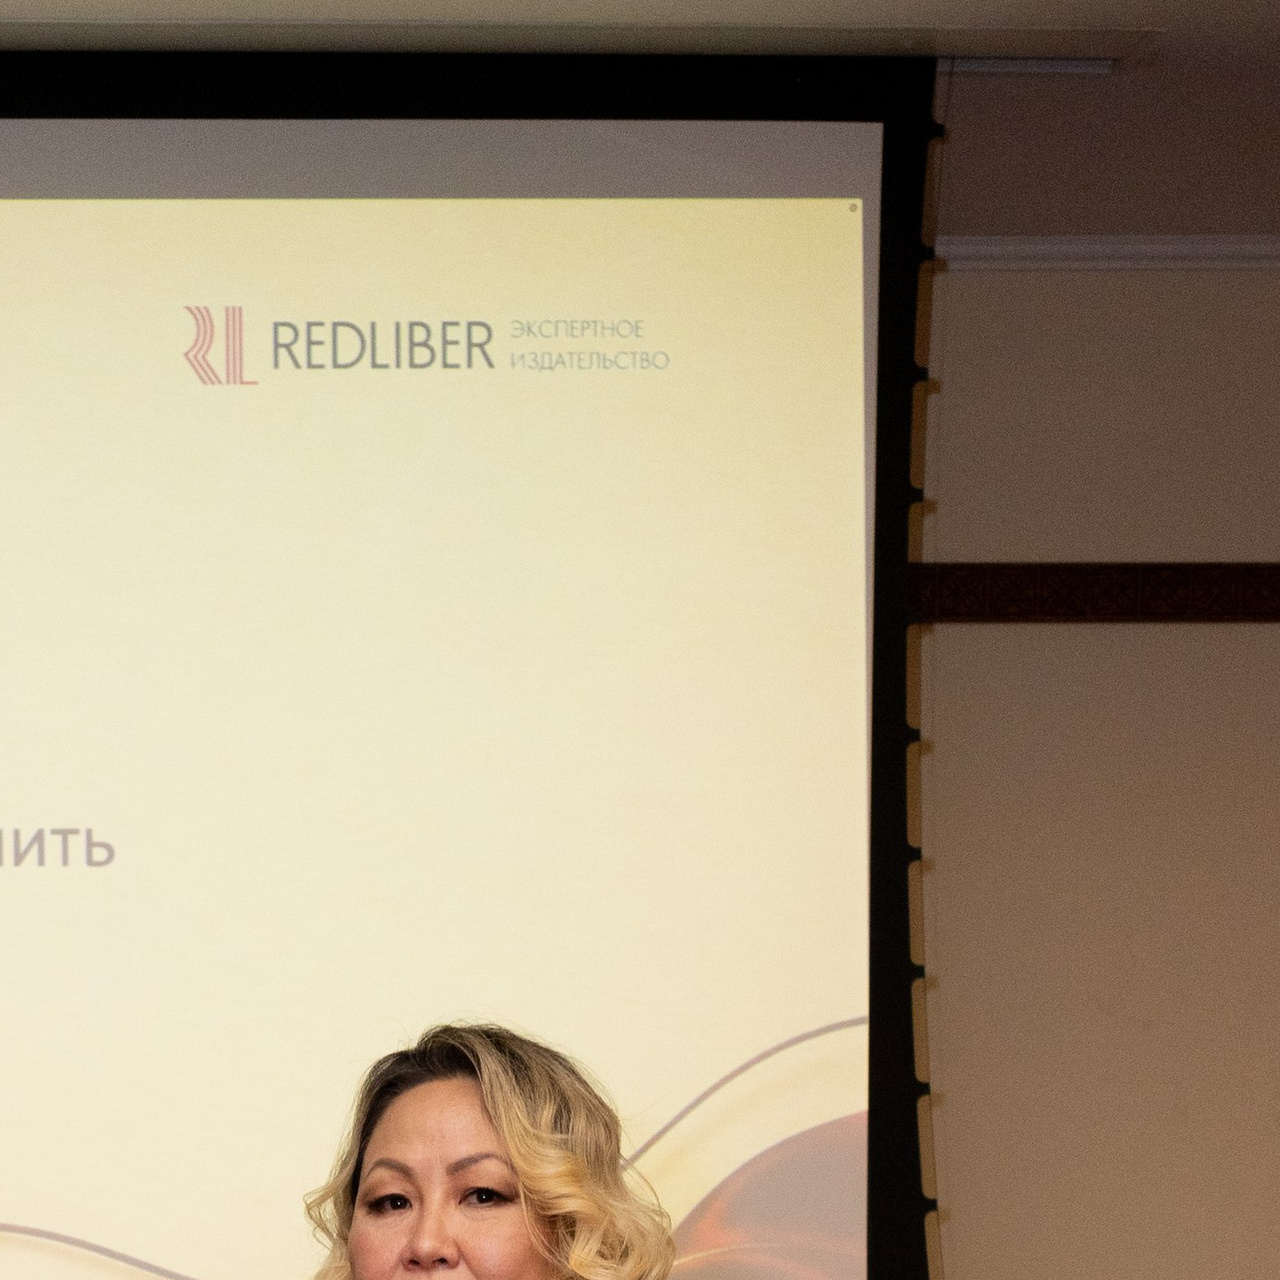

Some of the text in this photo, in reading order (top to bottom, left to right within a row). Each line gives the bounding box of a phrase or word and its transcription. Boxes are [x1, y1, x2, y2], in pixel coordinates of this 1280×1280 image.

[510, 319, 644, 339] ЭКСПЕРТНОЕ
[272, 320, 496, 369] REDLIBER
[510, 351, 670, 371] ИЗДАТЕЛЬСТВО
